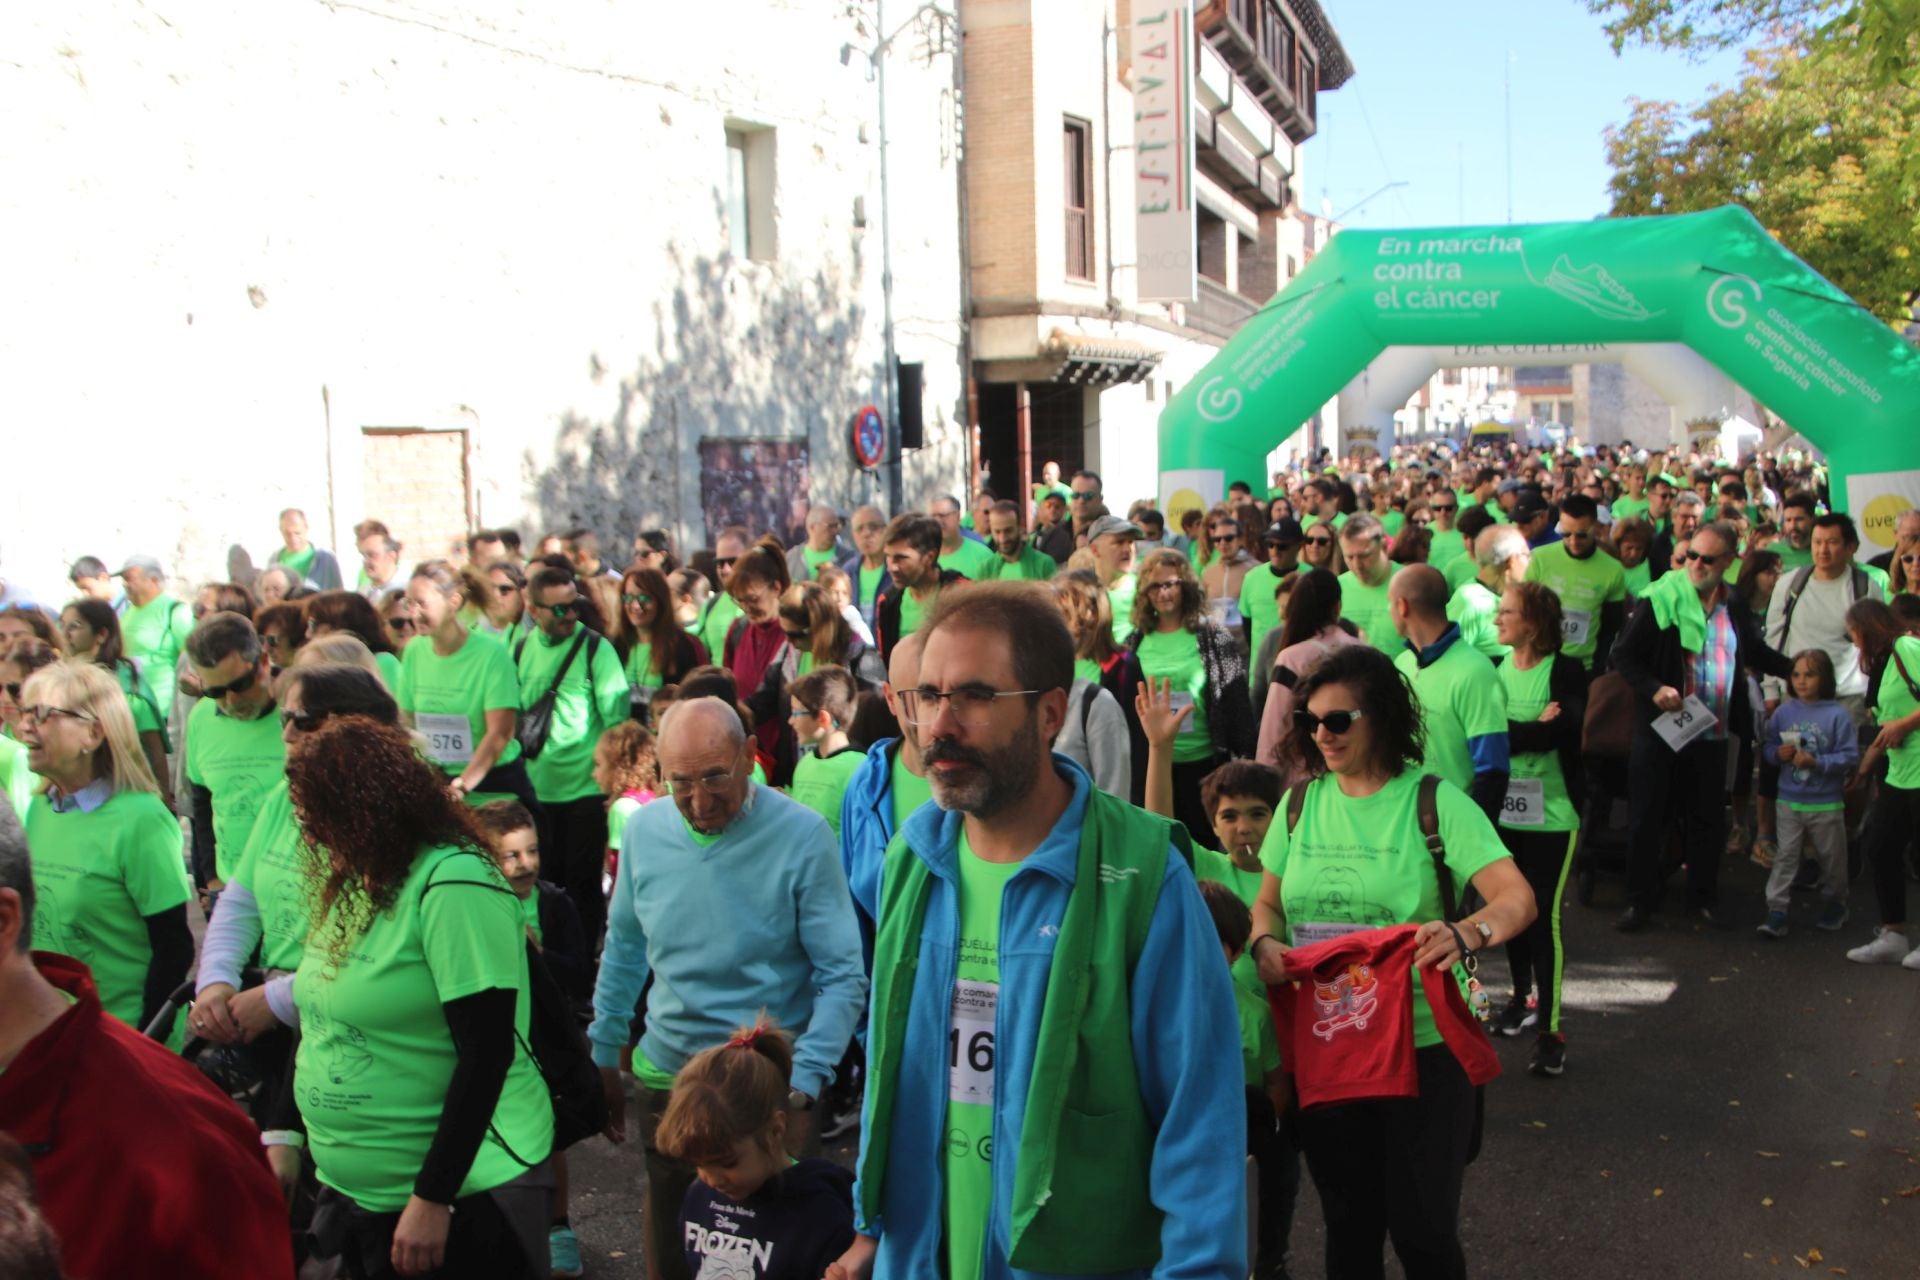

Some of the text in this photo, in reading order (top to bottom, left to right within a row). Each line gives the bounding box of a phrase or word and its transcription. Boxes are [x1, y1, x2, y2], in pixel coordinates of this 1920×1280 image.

[1377, 234, 1523, 255] En marcha
[1373, 259, 1462, 281] contra
[1374, 284, 1501, 309] el cáncer
[1745, 332, 1761, 350] en
[1865, 515, 1897, 528] uve
[685, 1221, 774, 1272] FROZEN
